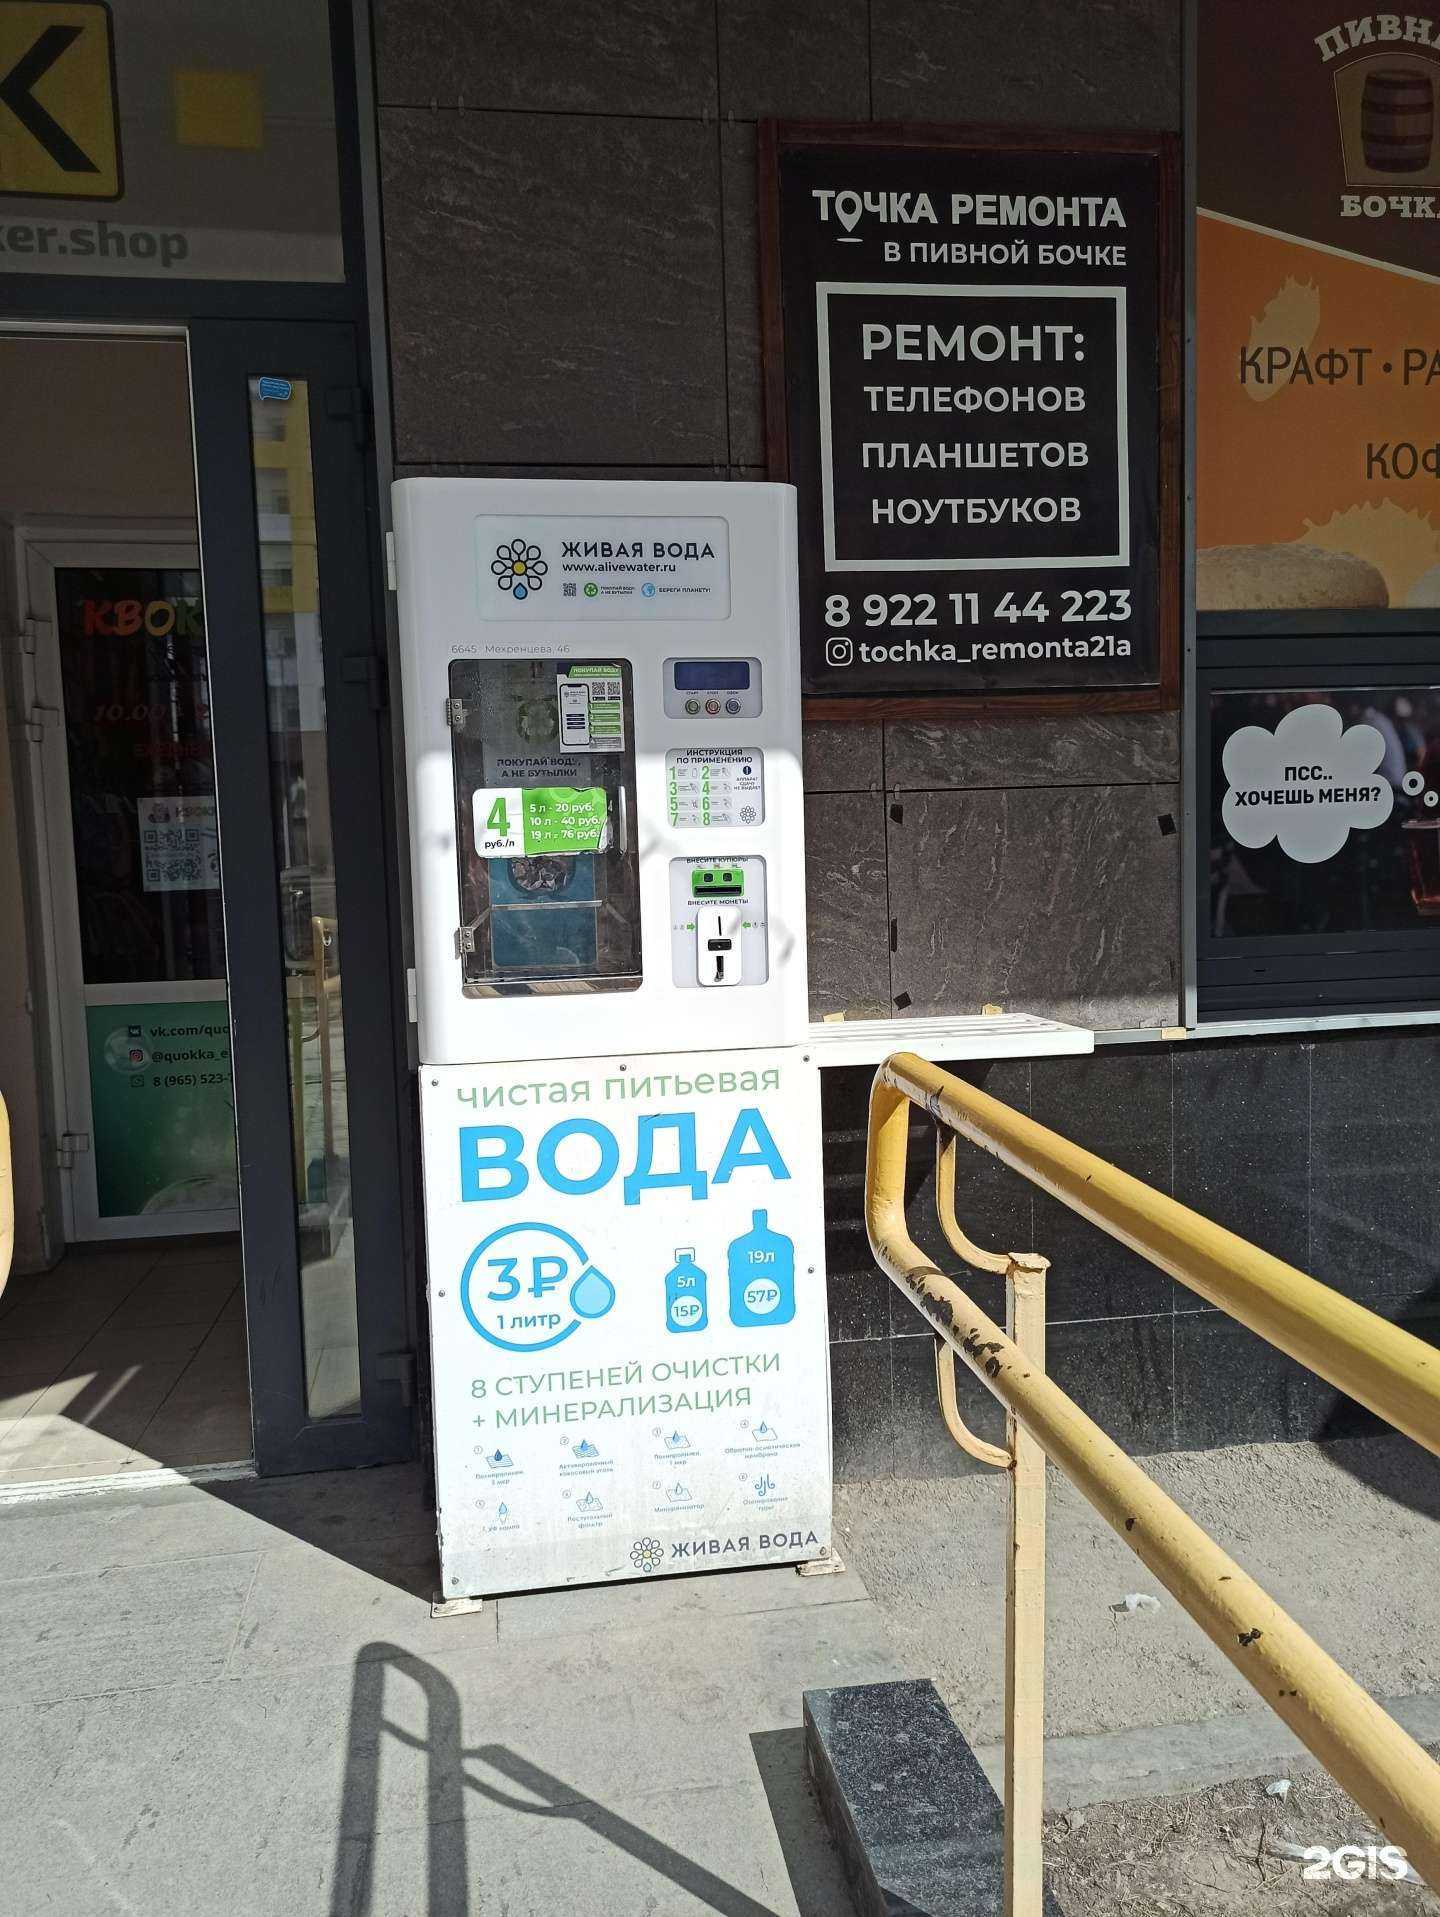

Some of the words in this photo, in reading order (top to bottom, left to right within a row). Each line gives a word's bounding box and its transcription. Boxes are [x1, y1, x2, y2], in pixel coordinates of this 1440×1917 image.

[812, 189, 938, 233] ТОЧКА
[951, 194, 1126, 227] РЕМОНТА
[884, 242, 901, 262] В
[911, 239, 1028, 265] ПИВНОЙ
[1038, 245, 1127, 266] БОЧКЕ
[862, 323, 1084, 362] РЕМОНТ:
[1240, 346, 1373, 386] КРАФТ
[864, 386, 1086, 413] ТЕЛЕФОНОВ
[862, 442, 1089, 468] ПЛАНШЕТОВ
[872, 497, 1081, 524] НОУТБУКОВ
[561, 541, 643, 558] ЖИВАЯ
[653, 542, 715, 560] ВОДА
[562, 562, 677, 574] www.alivewater.ru
[824, 594, 850, 627] 8
[862, 593, 937, 626] 922
[948, 592, 979, 625] 11
[993, 591, 1050, 623] 44
[1060, 589, 1132, 623] 223
[859, 635, 1132, 664] tochka_remonta21a
[497, 757, 547, 766] ПОКУПАЙ
[686, 749, 743, 757] ИНСТРУКЦИЯ
[528, 769, 577, 777] БУТЫЛКИ
[669, 766, 676, 779] 1
[702, 766, 710, 779] 2
[1284, 765, 1333, 781] ПСС..
[670, 782, 677, 795] 3
[702, 781, 710, 795] 4
[1235, 789, 1314, 807] ХОЧЕШЬ
[1318, 786, 1381, 804] МЕНЯ?
[529, 805, 537, 813] 5
[555, 804, 569, 812] 20
[572, 803, 594, 814] руб.
[670, 798, 678, 811] 5
[703, 797, 710, 810] 6
[487, 797, 511, 837] 4
[530, 818, 541, 826] 10
[561, 817, 575, 825] 40
[578, 816, 600, 827] руб.
[670, 813, 679, 827] 7
[703, 812, 711, 826] 8
[485, 839, 515, 849] руб./л
[531, 831, 541, 839] 19
[544, 831, 551, 839] л
[561, 830, 574, 838] 76
[151, 1048, 232, 1066] @quokka_e
[153, 1075, 161, 1087] 8
[164, 1073, 198, 1089] (965)
[457, 1080, 590, 1109] чистая
[605, 1068, 780, 1100] питьевая
[459, 1108, 792, 1206] ВОДА
[748, 1250, 776, 1264] 19л
[677, 1276, 696, 1288] 5л
[497, 1315, 505, 1329] 1
[510, 1313, 561, 1332] литр
[471, 1379, 487, 1398] 8
[496, 1360, 643, 1397] СТУПЕНЕЙ
[652, 1353, 780, 1382] ОЧИСТКИ
[496, 1387, 751, 1429] МИНЕРАЛИЗАЦИЯ
[671, 1536, 749, 1558] ЖИВАЯ
[759, 1530, 818, 1549] ВОДА
